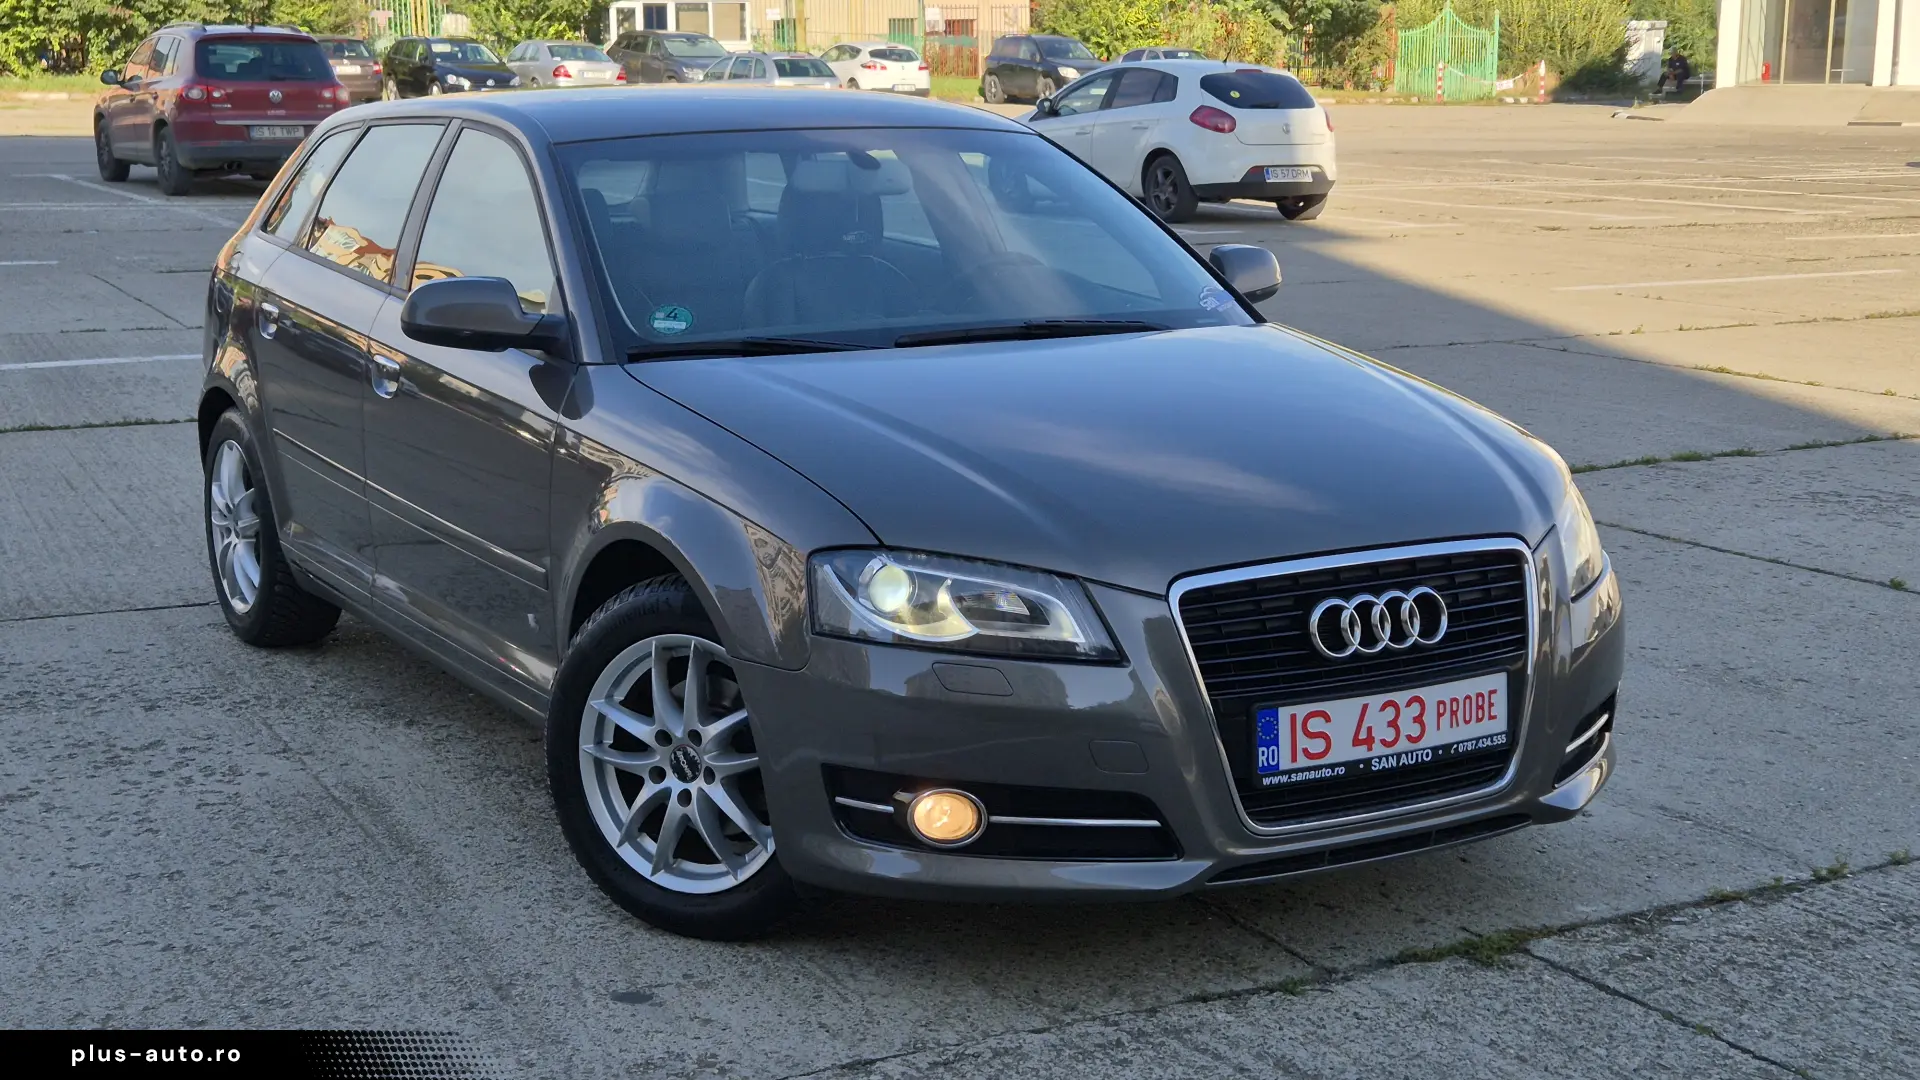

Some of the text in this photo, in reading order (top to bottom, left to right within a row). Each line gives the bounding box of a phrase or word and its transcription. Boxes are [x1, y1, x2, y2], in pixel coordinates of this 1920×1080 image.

[1270, 168, 1279, 178] IS
[1281, 168, 1290, 178] 57
[666, 307, 678, 320] 4
[1289, 688, 1498, 763] IS 433 PROBE
[1258, 745, 1278, 768] RO
[1262, 733, 1507, 786] www.sanauto.ro SAN AUTO 0787.434.555
